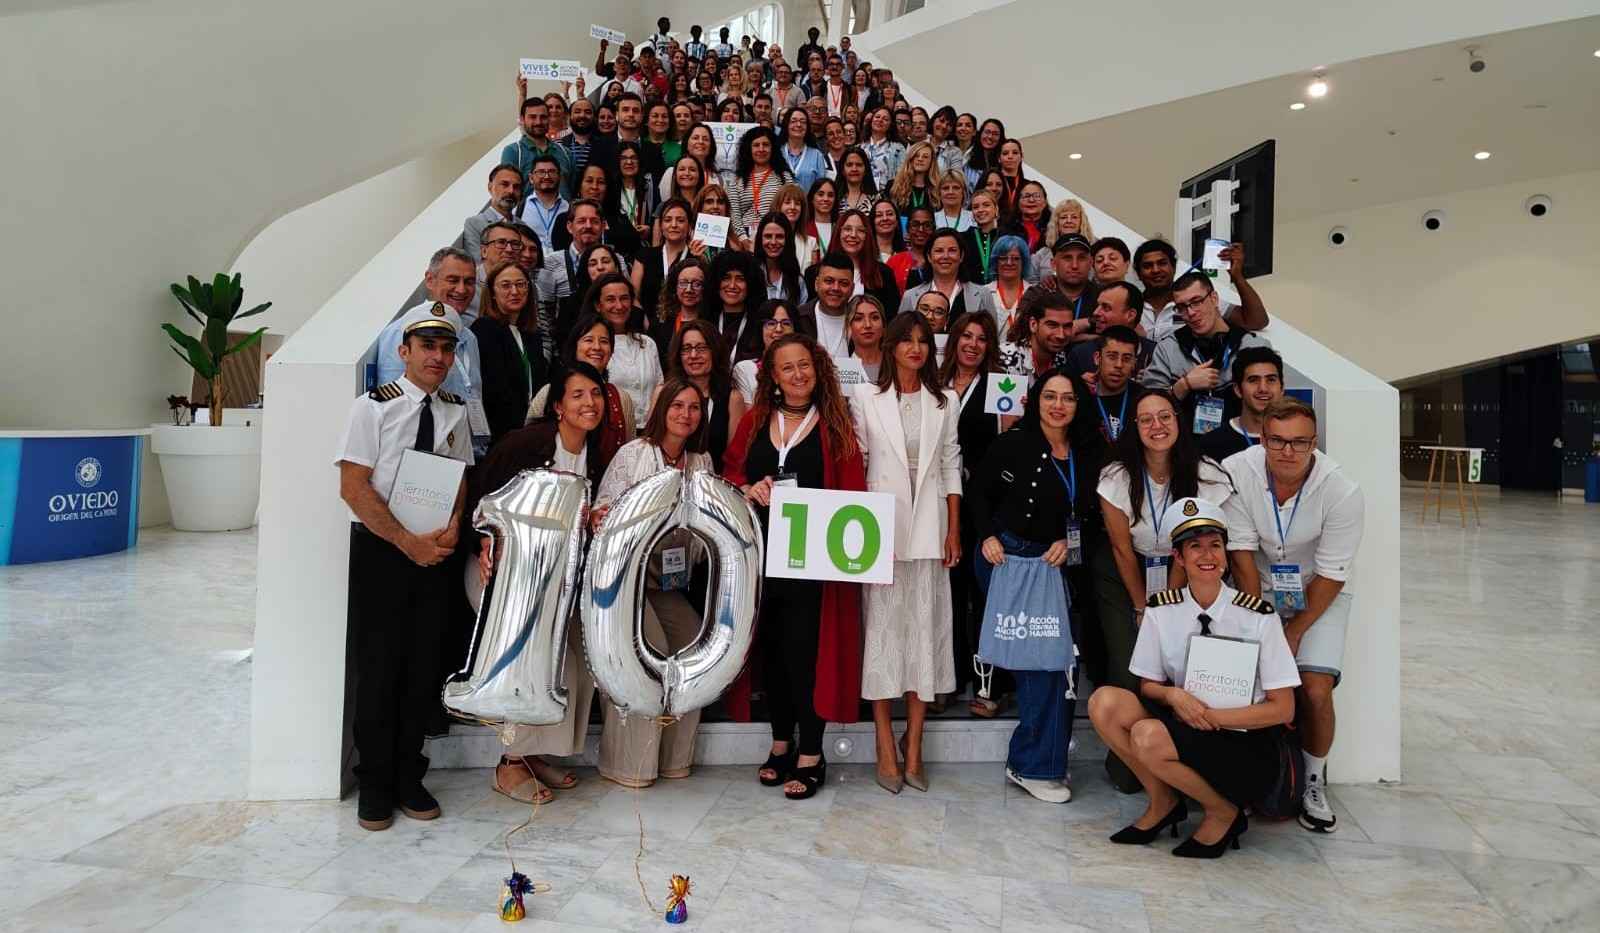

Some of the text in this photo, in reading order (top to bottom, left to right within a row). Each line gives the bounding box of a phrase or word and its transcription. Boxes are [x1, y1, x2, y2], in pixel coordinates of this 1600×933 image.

[1471, 458, 1480, 480] 5
[48, 490, 119, 513] OVIEDO
[48, 512, 79, 522] ORIGEN
[80, 510, 94, 520] DEL
[782, 502, 881, 575] 10
[996, 612, 1016, 628] 10
[1193, 669, 1249, 687] Territorio
